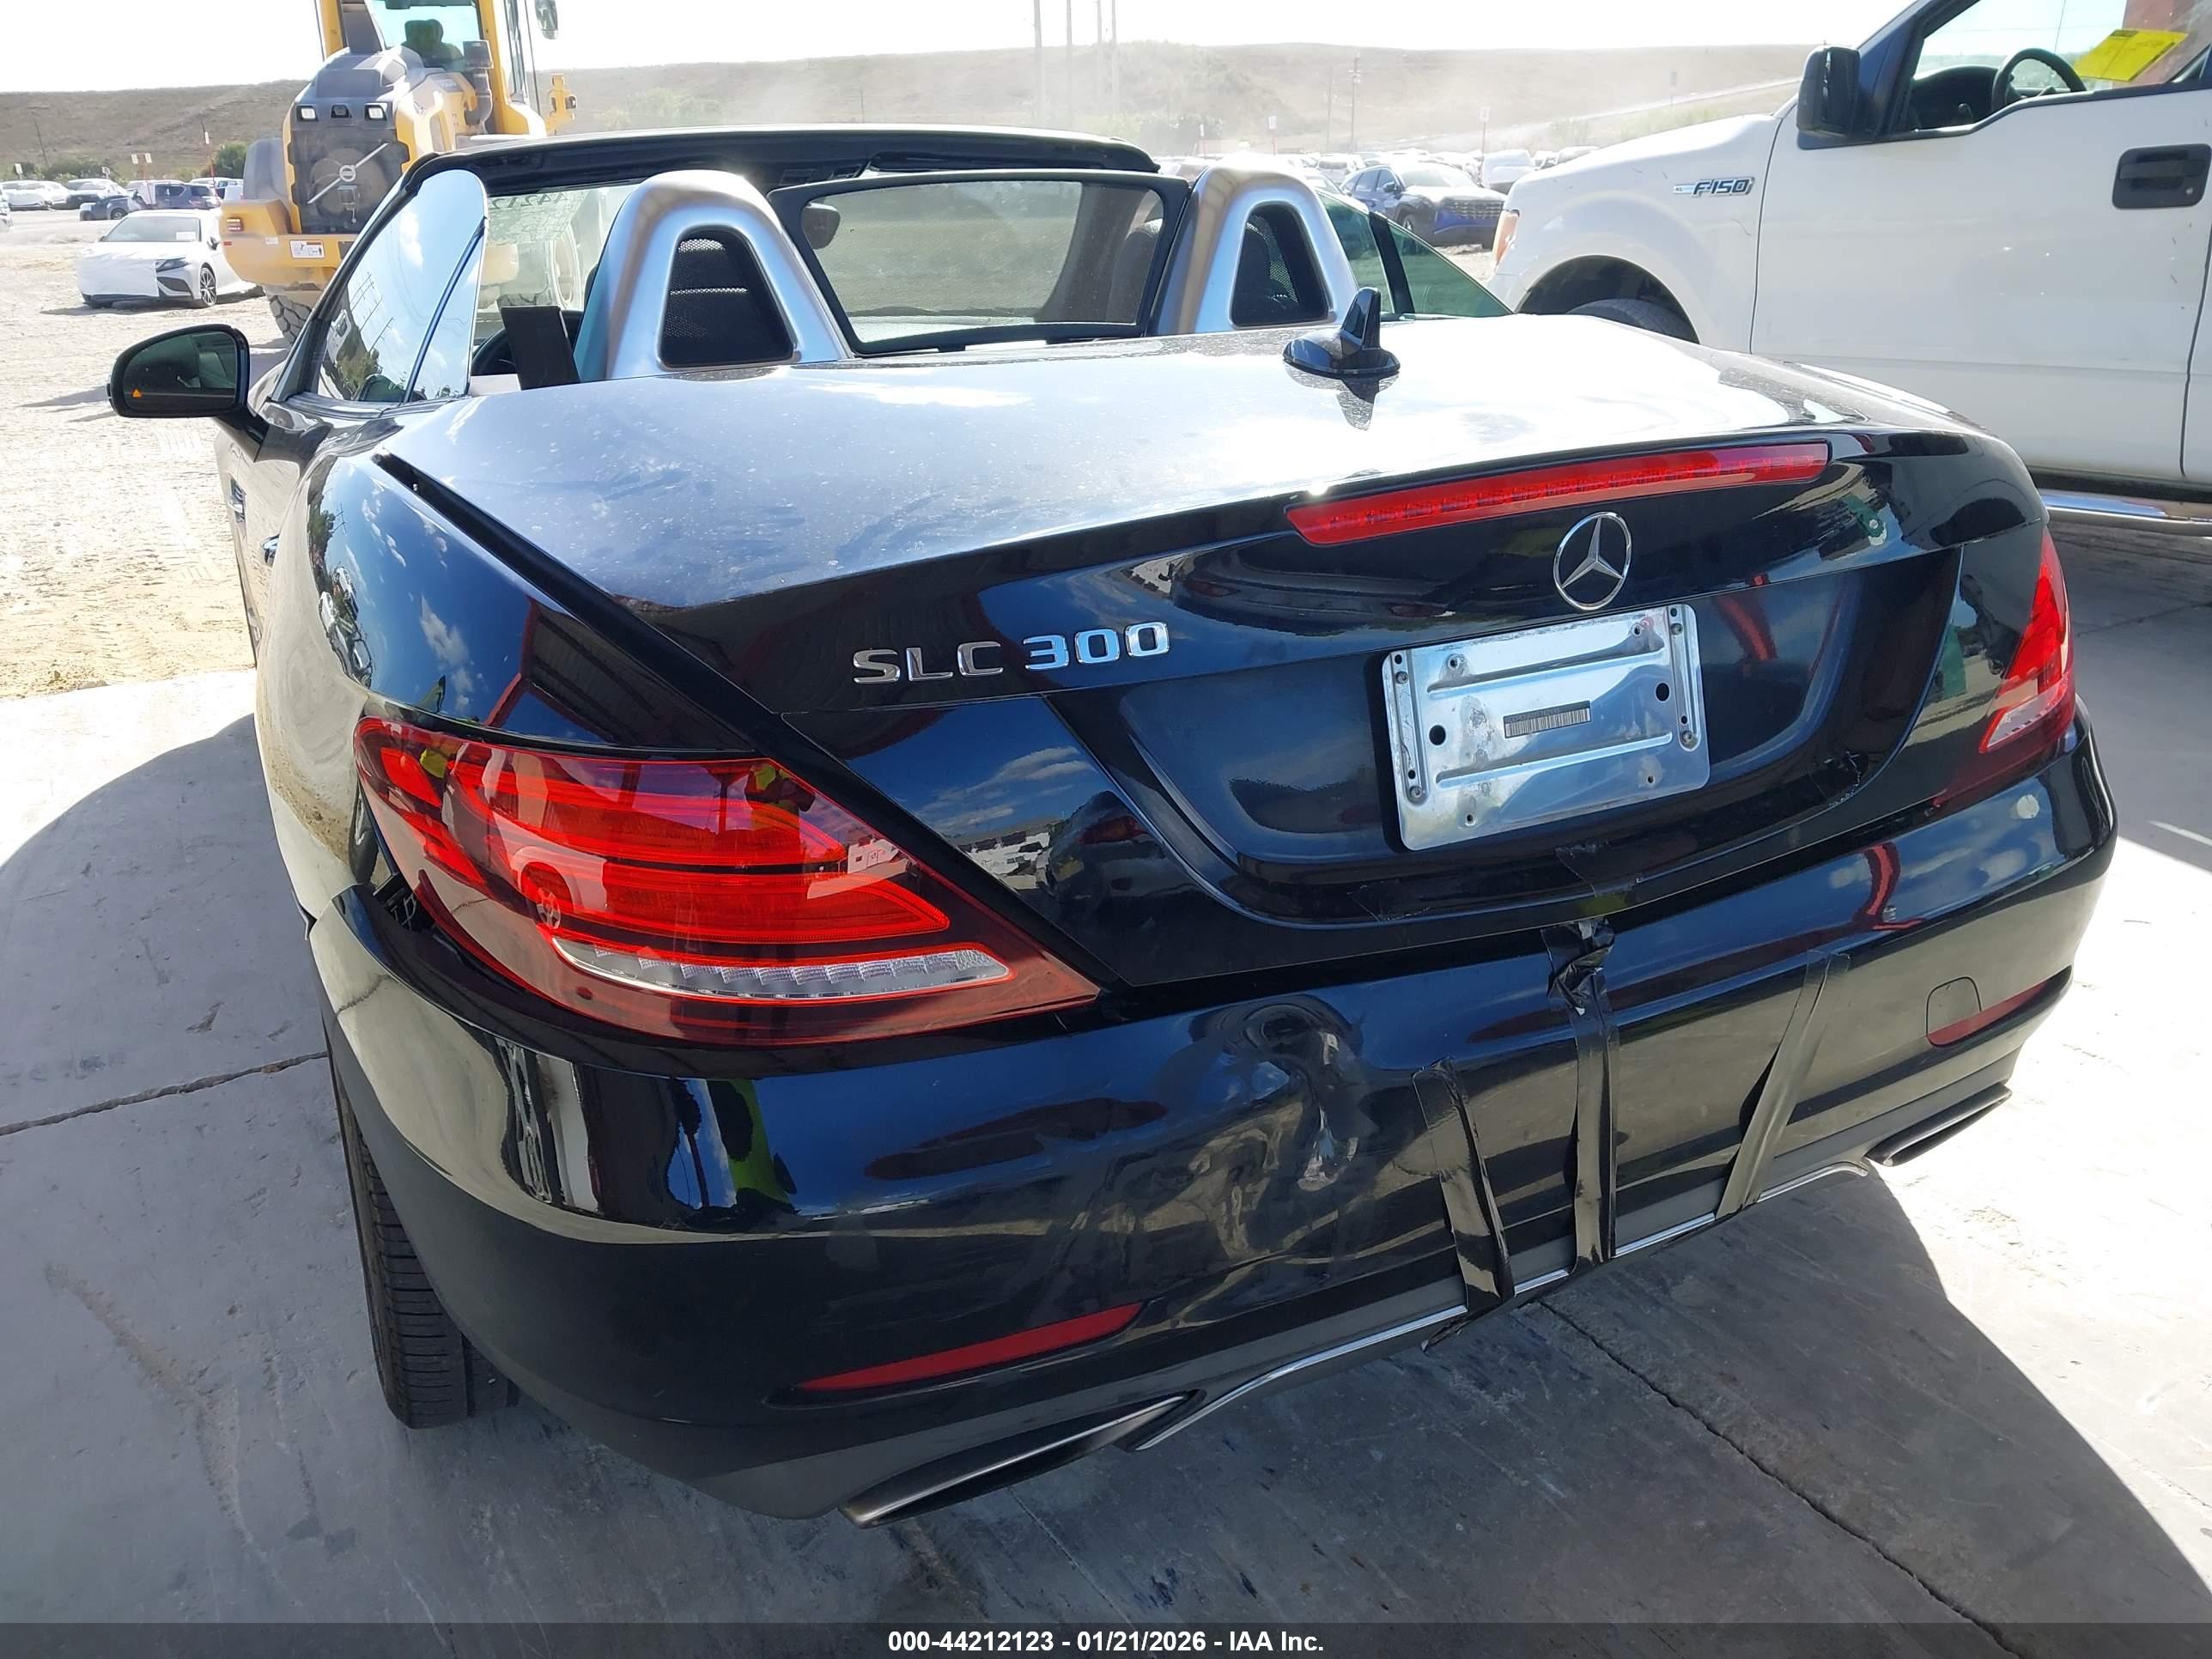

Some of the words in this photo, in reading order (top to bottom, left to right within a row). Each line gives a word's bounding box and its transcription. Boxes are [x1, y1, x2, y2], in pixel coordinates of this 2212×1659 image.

[1692, 178, 1752, 196] F-150
[853, 641, 1004, 684] SLC
[1023, 622, 1170, 670] 300
